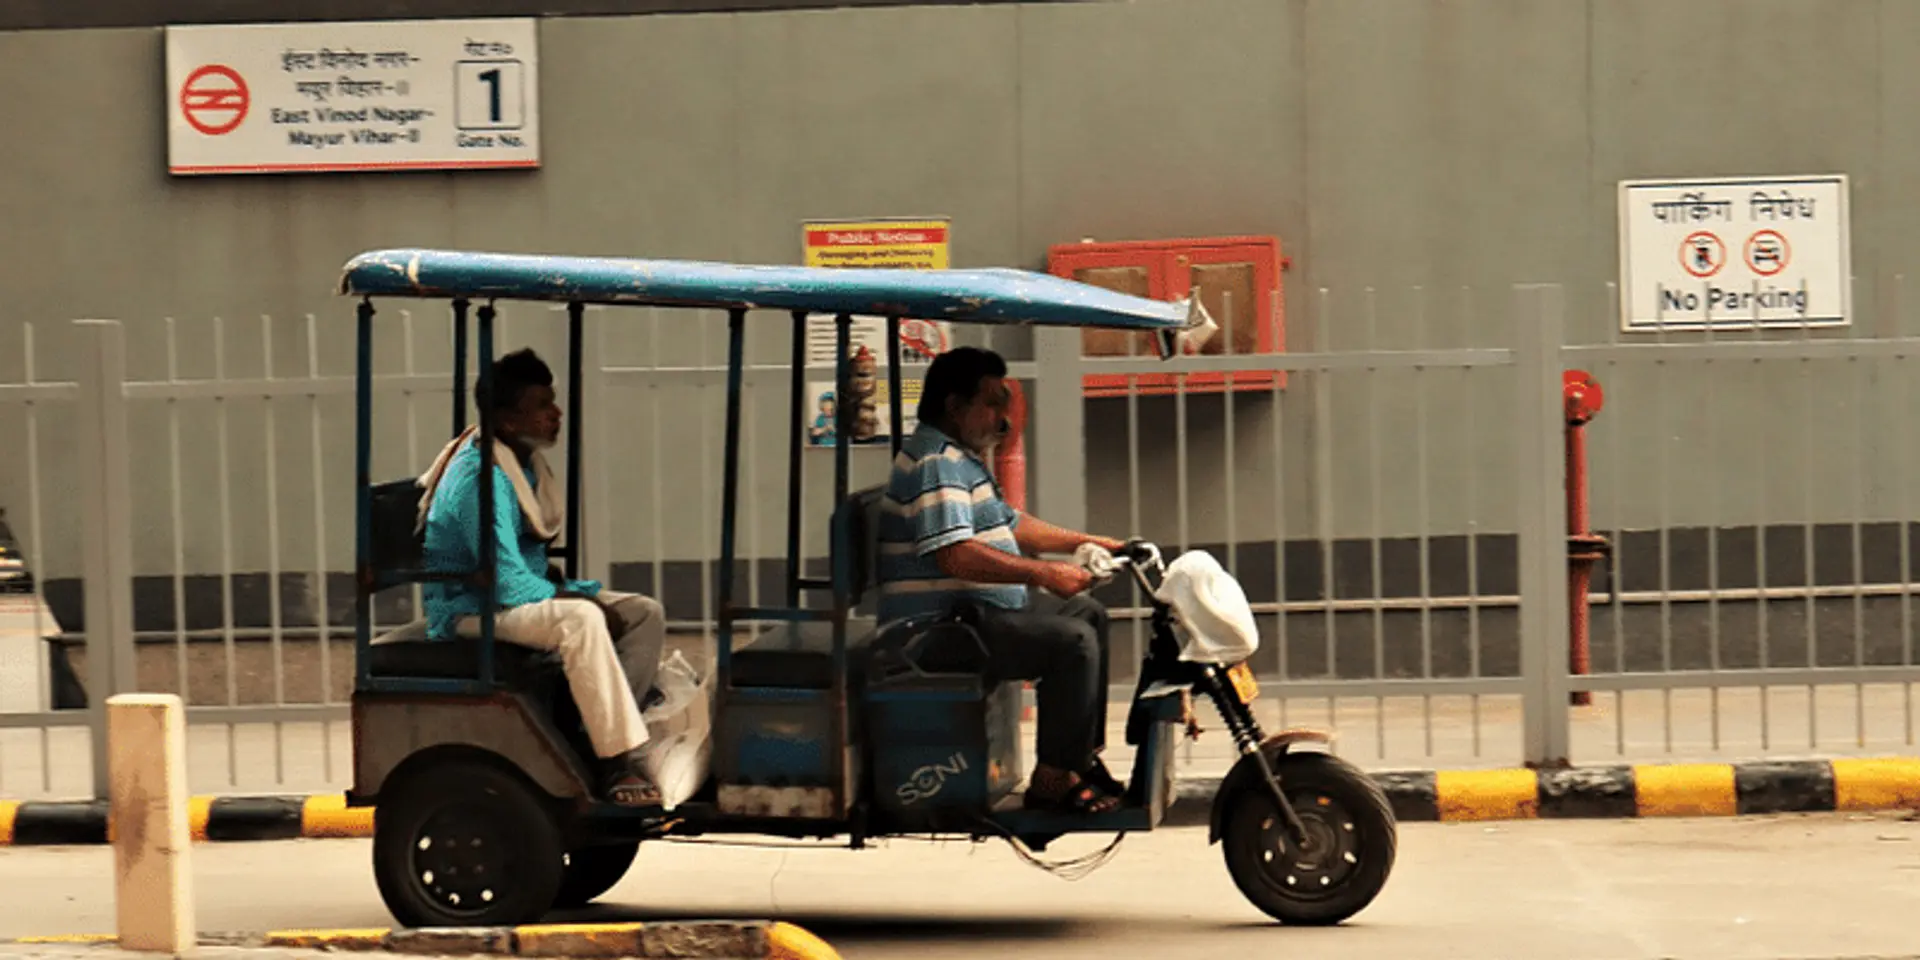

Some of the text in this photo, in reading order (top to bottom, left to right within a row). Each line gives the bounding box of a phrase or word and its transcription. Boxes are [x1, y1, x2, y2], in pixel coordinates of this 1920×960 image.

[478, 69, 501, 122] 1
[270, 107, 310, 123] East
[314, 107, 368, 122] Vinod
[288, 130, 345, 149] Mayur
[456, 133, 494, 148] Gate
[1750, 190, 1815, 221] निषेध
[1660, 286, 1807, 313] No Parking
[896, 751, 969, 805] SONI
